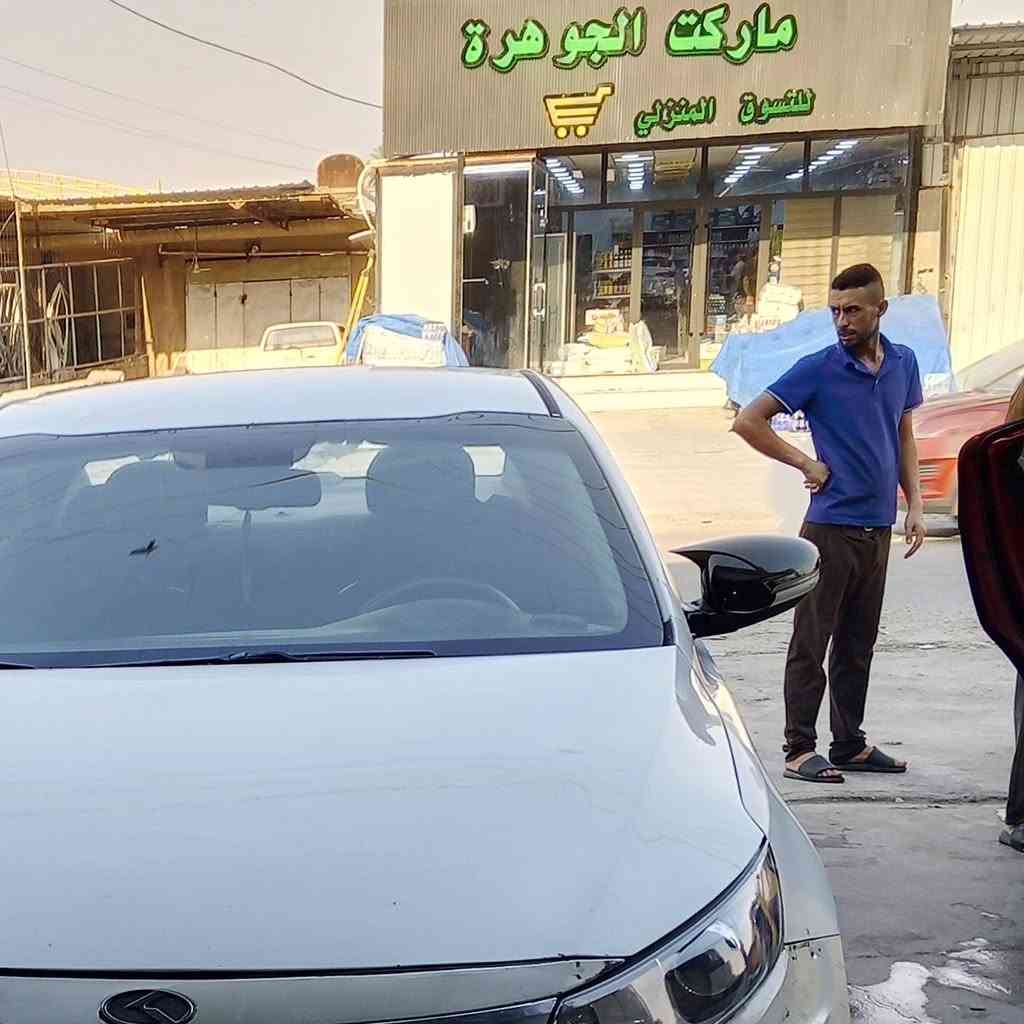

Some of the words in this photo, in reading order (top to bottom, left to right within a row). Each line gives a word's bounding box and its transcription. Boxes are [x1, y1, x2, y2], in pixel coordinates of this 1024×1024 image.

[665, 3, 798, 64] ماركت
[634, 96, 717, 137] المنزلي
[738, 88, 816, 125] للتسوق
